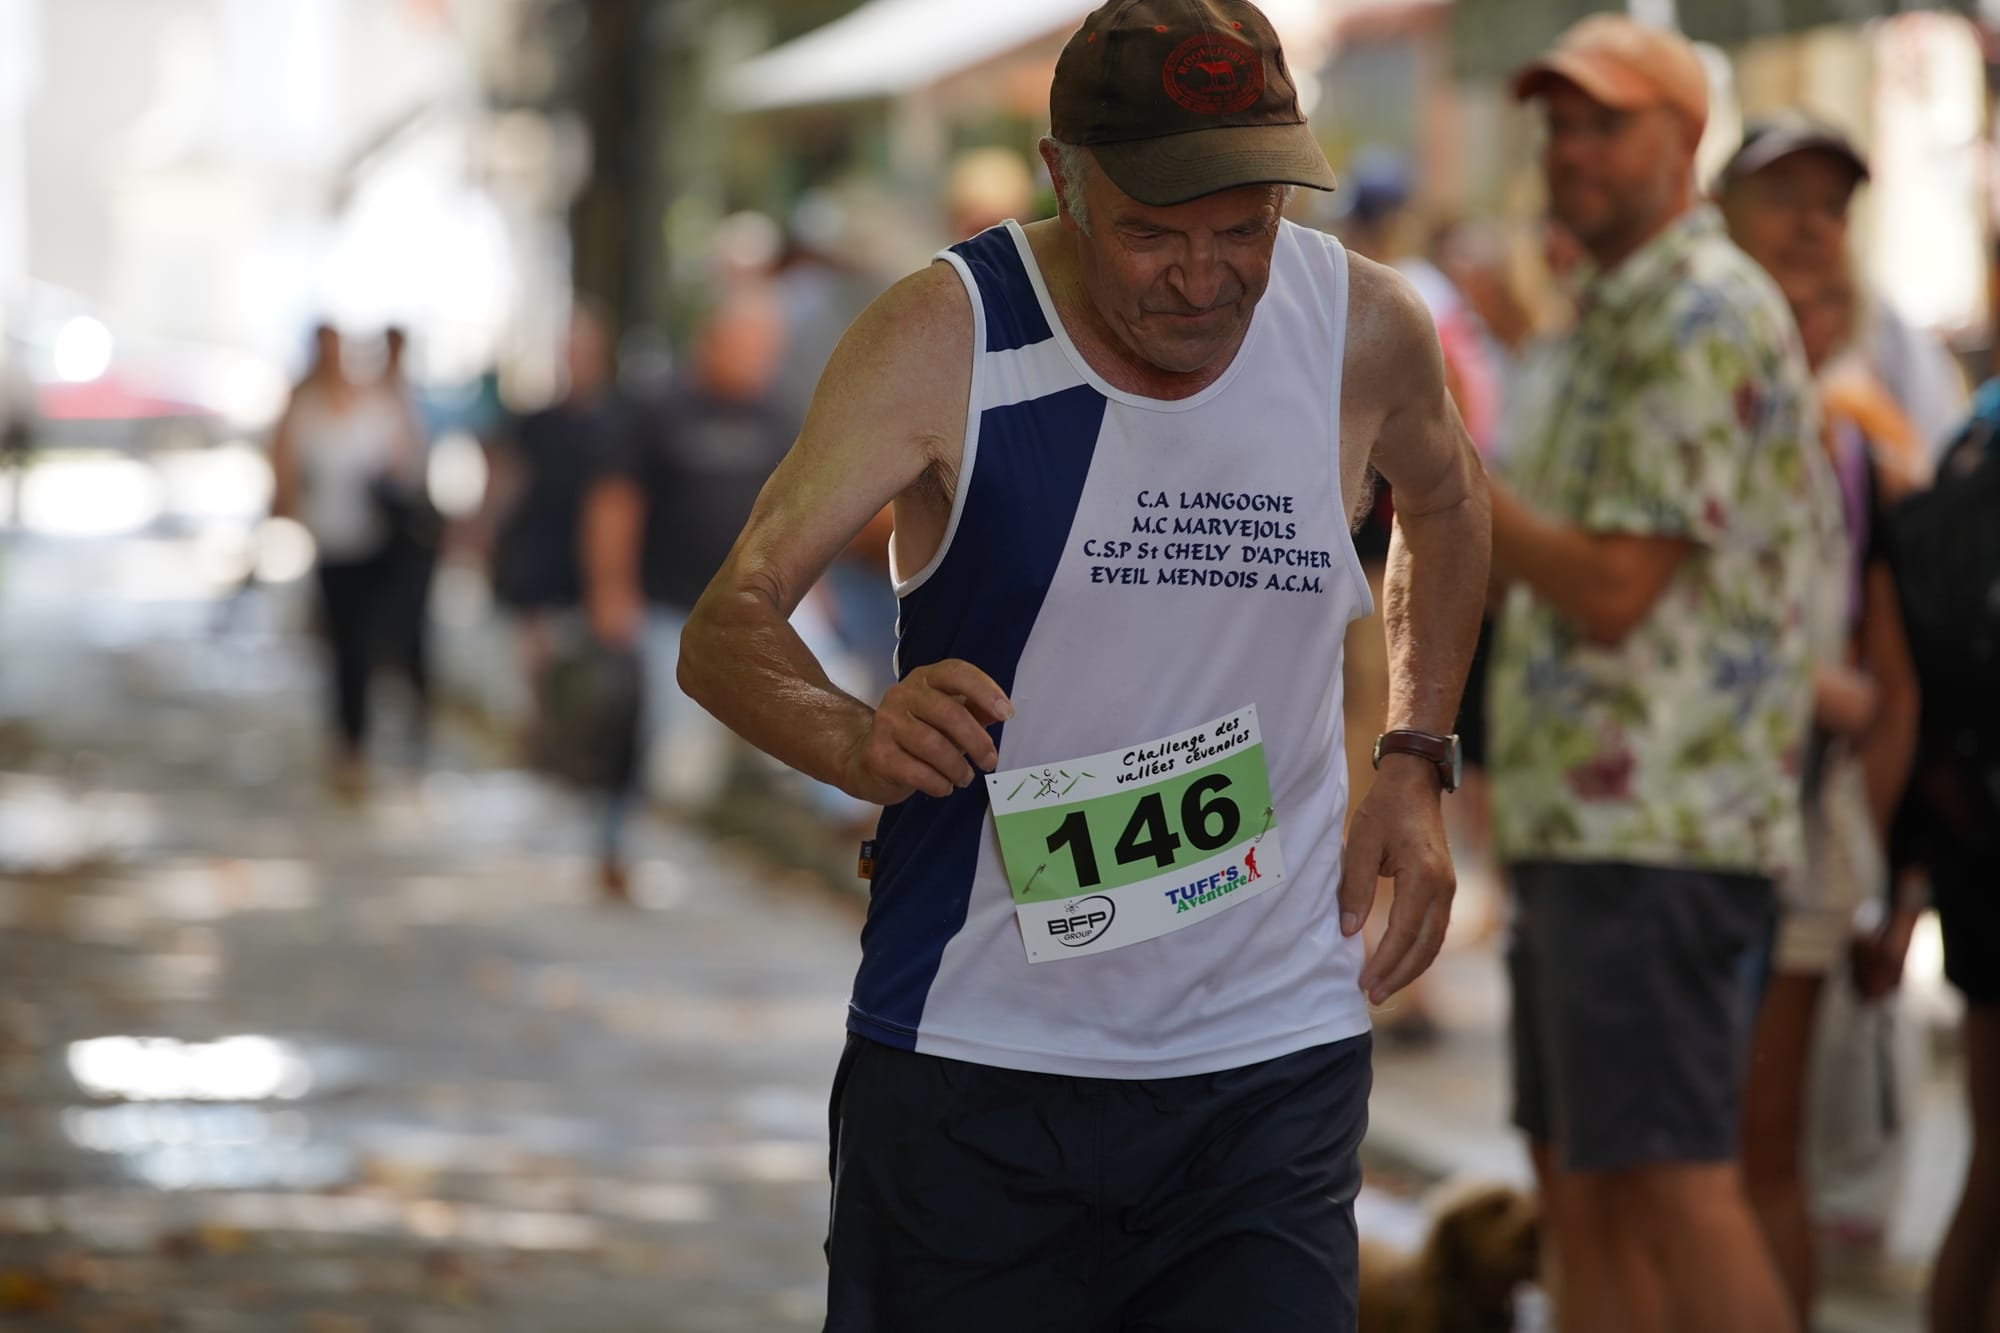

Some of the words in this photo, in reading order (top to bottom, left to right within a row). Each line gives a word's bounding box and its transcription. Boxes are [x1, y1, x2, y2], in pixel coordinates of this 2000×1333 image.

[1137, 490, 1170, 510] C.A
[1179, 491, 1294, 514] LANGOGNE
[1131, 516, 1168, 535] M.C
[1172, 517, 1296, 541] MARVEJOLS
[1083, 539, 1132, 559] C.S.P
[1137, 542, 1158, 560] St
[1163, 543, 1231, 562] CHELY
[1241, 545, 1332, 569] D'APCHER
[1090, 566, 1150, 585] EVEIL
[1156, 568, 1259, 589] MENDOIS
[1264, 573, 1323, 594] A.C.M.
[1116, 758, 1175, 784] vallées
[1185, 729, 1250, 764] cévenoles
[1123, 733, 1206, 766] Challenge
[1215, 717, 1240, 737] des
[1046, 773, 1241, 888] 146
[1165, 865, 1239, 905] TUFF'S
[1176, 873, 1248, 914] Aventure
[1047, 910, 1107, 936] BFP
[1063, 929, 1093, 941] GROUP
